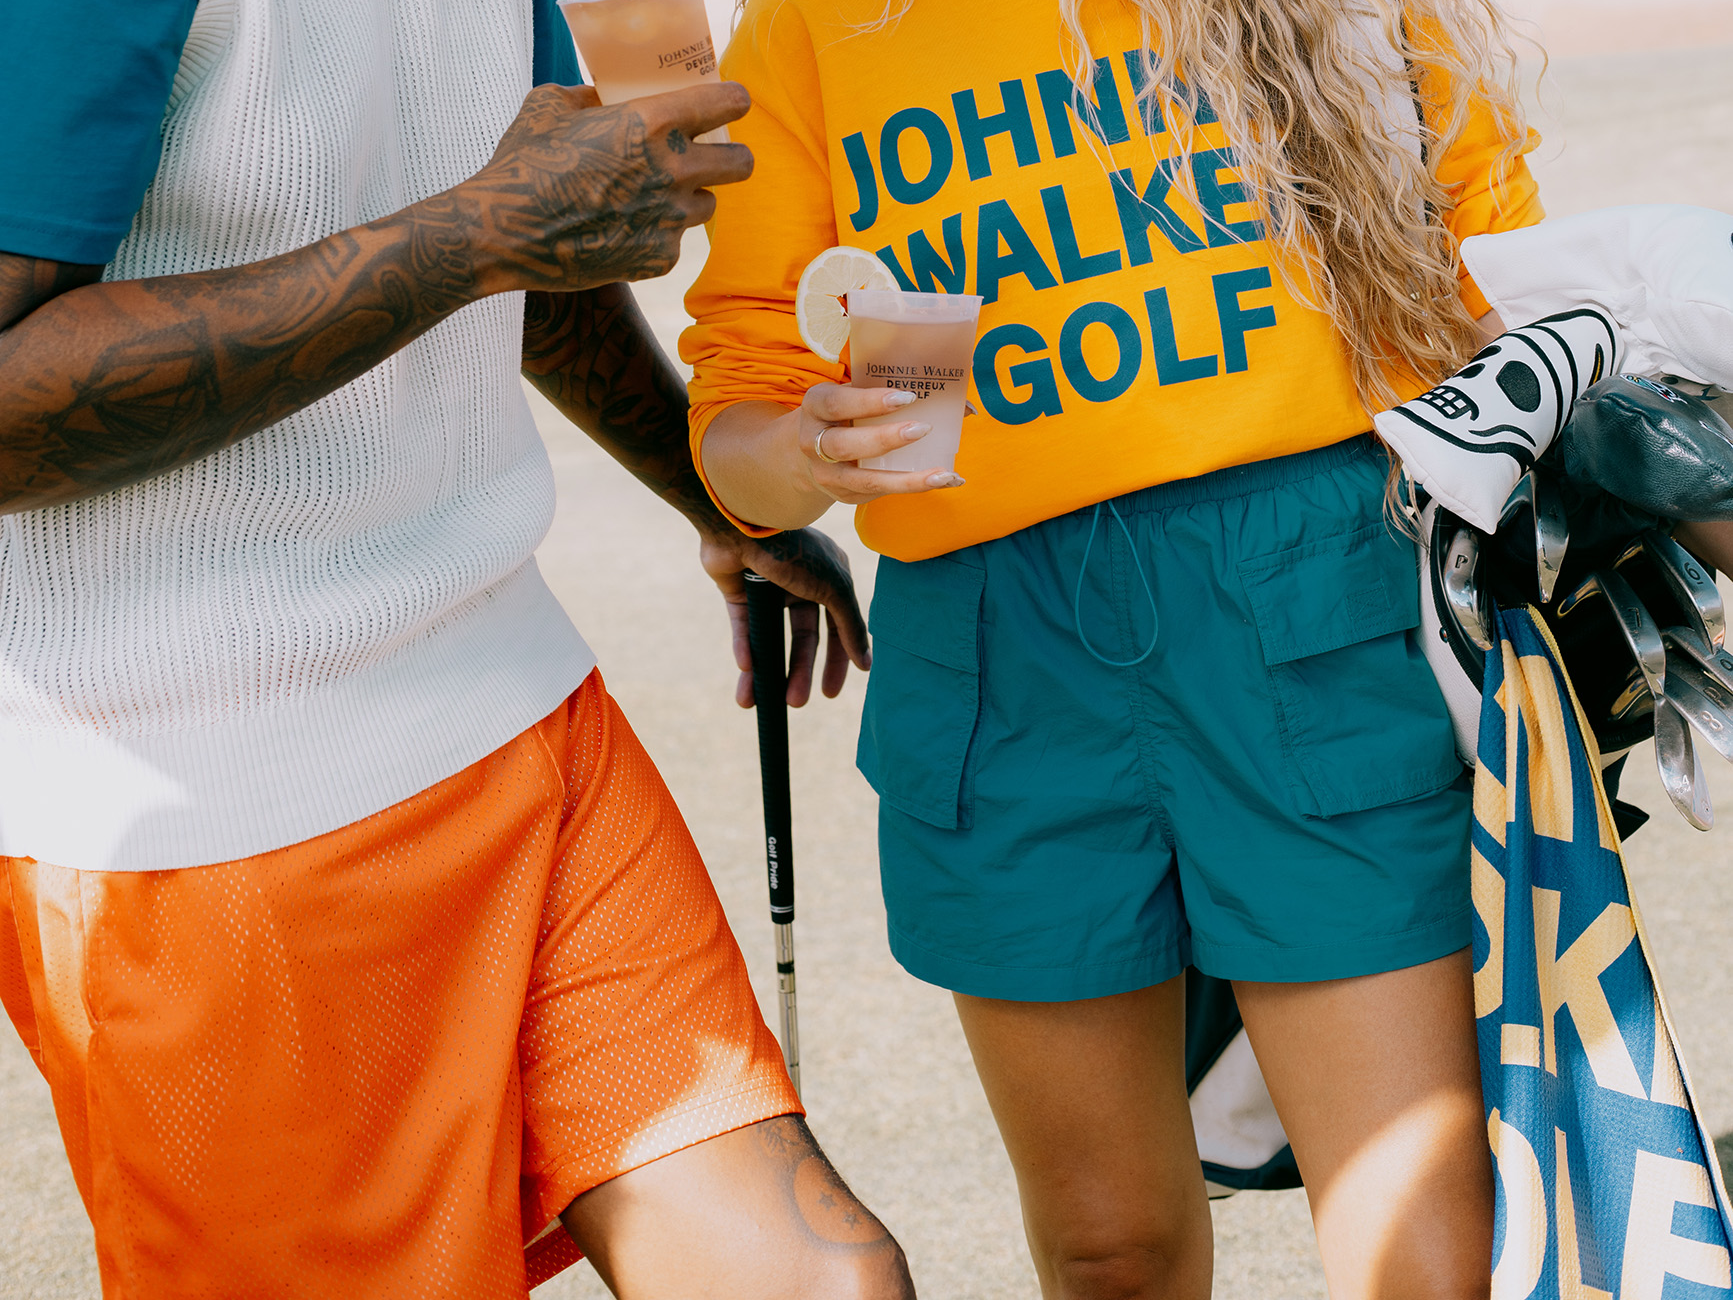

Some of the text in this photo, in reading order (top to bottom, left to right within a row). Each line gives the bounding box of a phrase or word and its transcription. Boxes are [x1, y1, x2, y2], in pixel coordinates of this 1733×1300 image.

[658, 40, 704, 69] JOHNNIE
[685, 51, 714, 71] DEVERE
[841, 47, 1221, 232] JOHNN
[875, 145, 1280, 309] WALKE
[972, 266, 1278, 426] GOLF
[865, 362, 965, 377] JOHNNIE WALKER
[886, 379, 946, 391] DEVEREUX
[1454, 554, 1469, 569] P
[1701, 710, 1724, 732] 8
[1672, 774, 1690, 787] 54
[767, 836, 779, 890] Golf Pride
